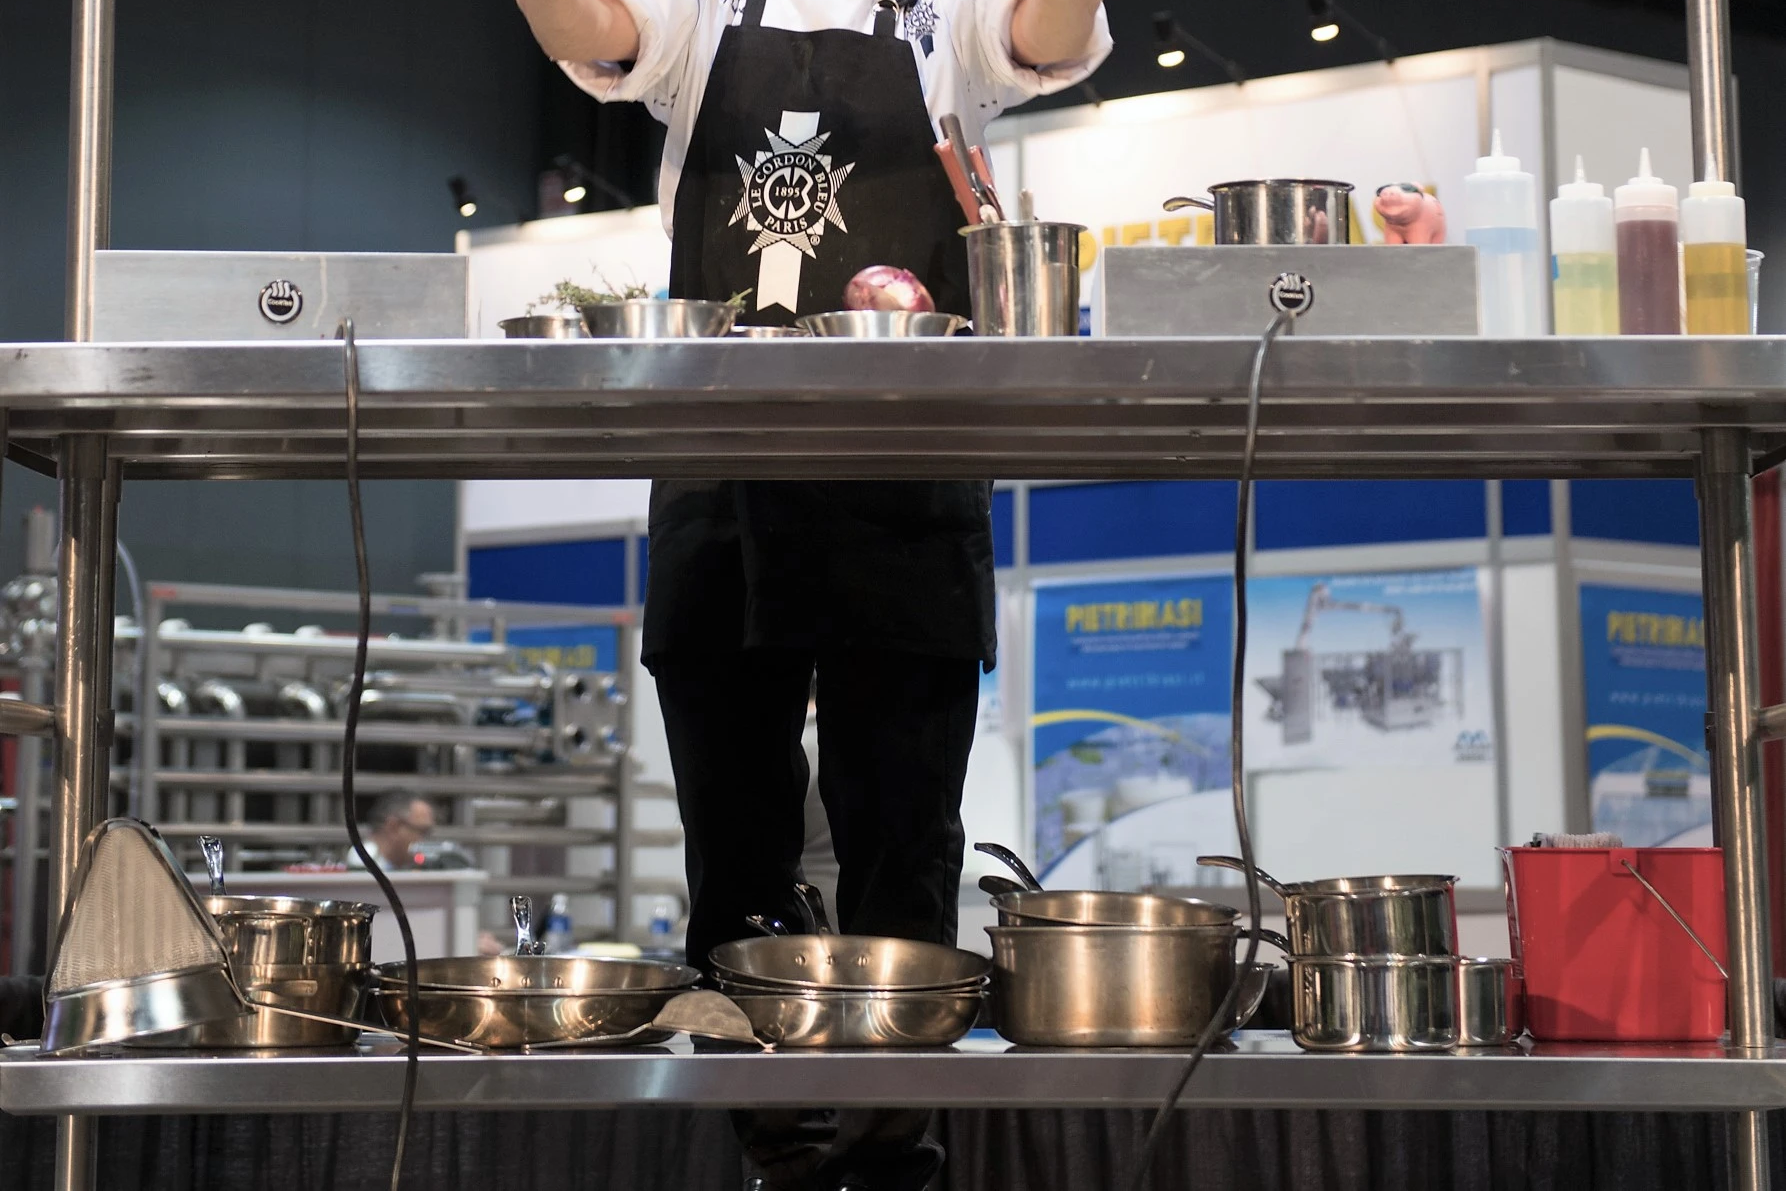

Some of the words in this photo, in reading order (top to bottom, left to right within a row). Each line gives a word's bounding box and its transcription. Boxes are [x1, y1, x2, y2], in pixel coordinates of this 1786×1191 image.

[755, 154, 817, 184] CORDON
[751, 188, 762, 208] LE
[775, 186, 800, 197] 1895
[813, 172, 828, 214] BLEU
[764, 215, 808, 233] PARIS
